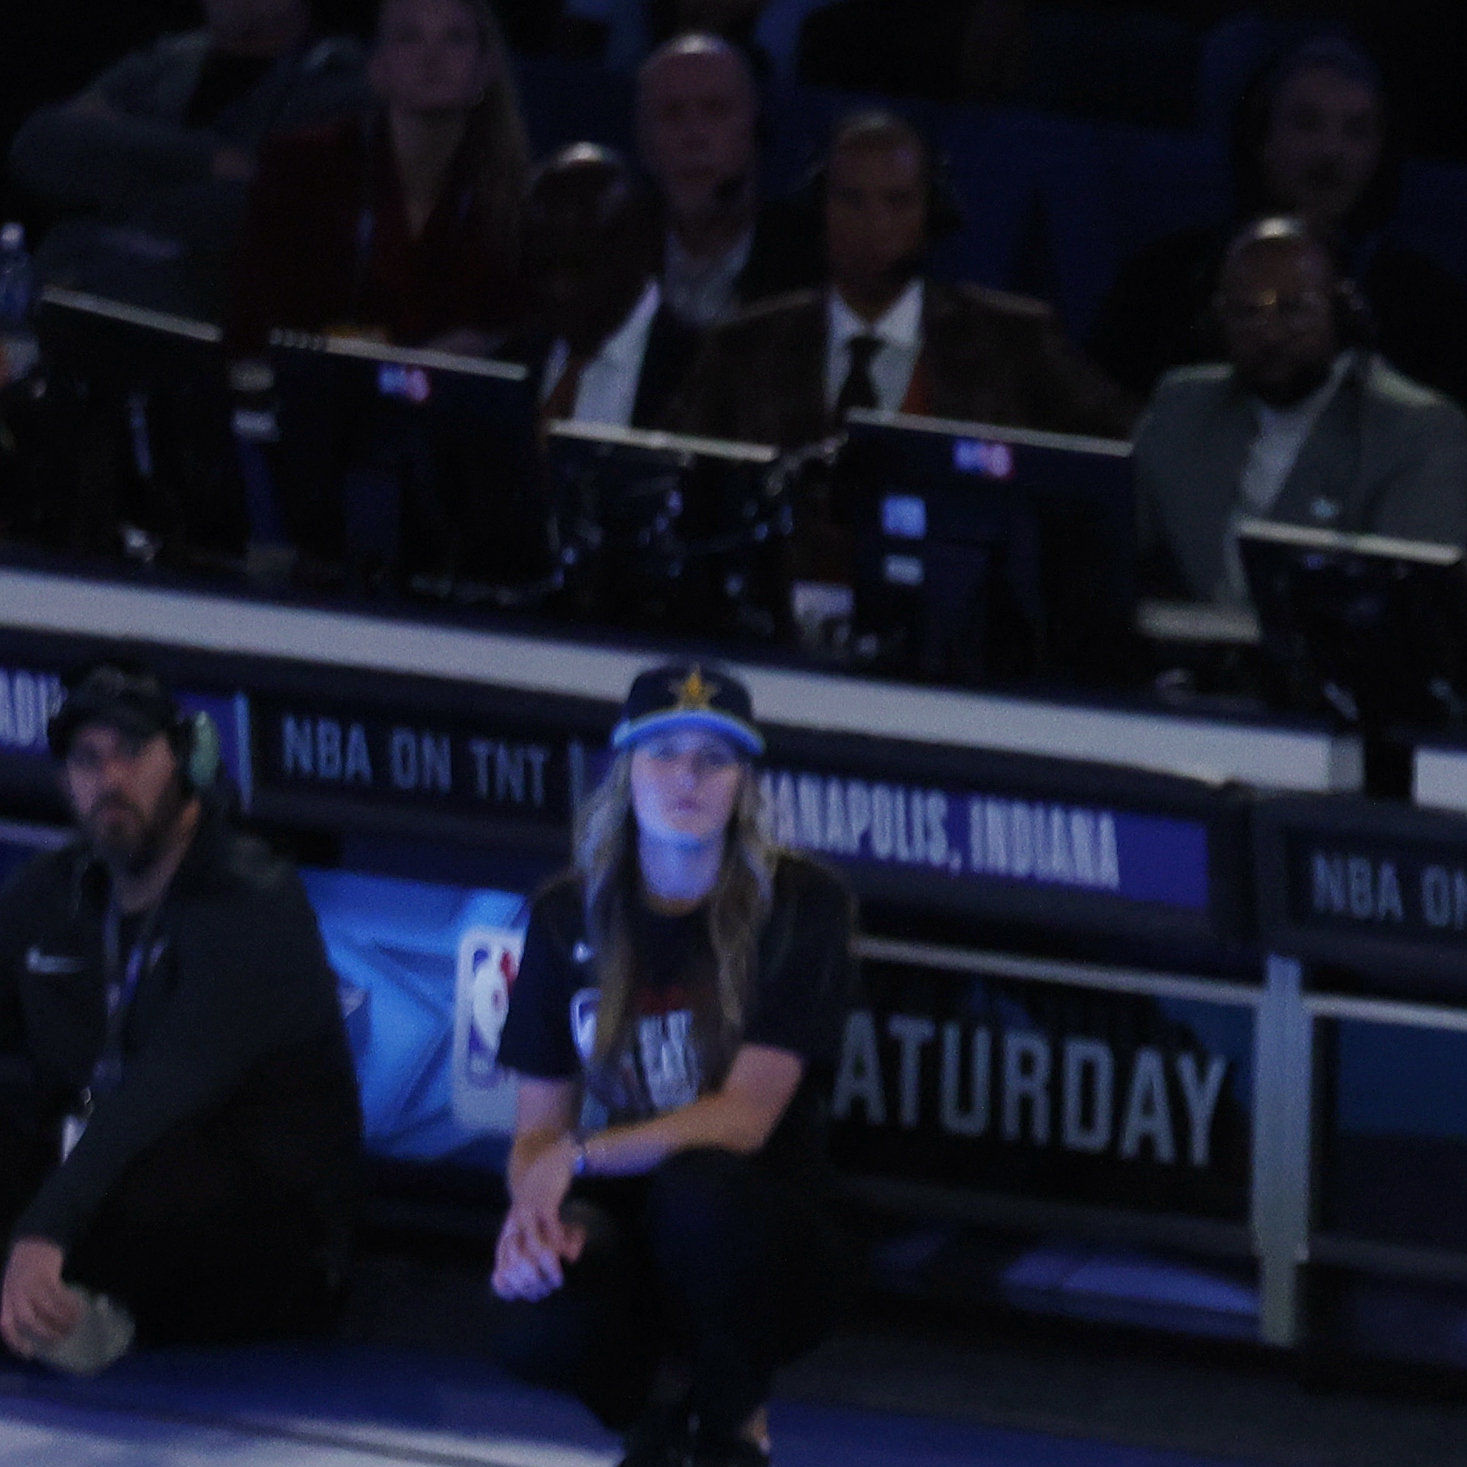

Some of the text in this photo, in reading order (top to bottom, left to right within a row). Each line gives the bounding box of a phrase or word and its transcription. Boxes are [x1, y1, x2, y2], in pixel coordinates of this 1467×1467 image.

[281, 712, 547, 806] NBA ON TNT
[969, 794, 1120, 891] INDIANA
[1312, 852, 1404, 922] NBA
[831, 1009, 1229, 1169] ATURDAY
